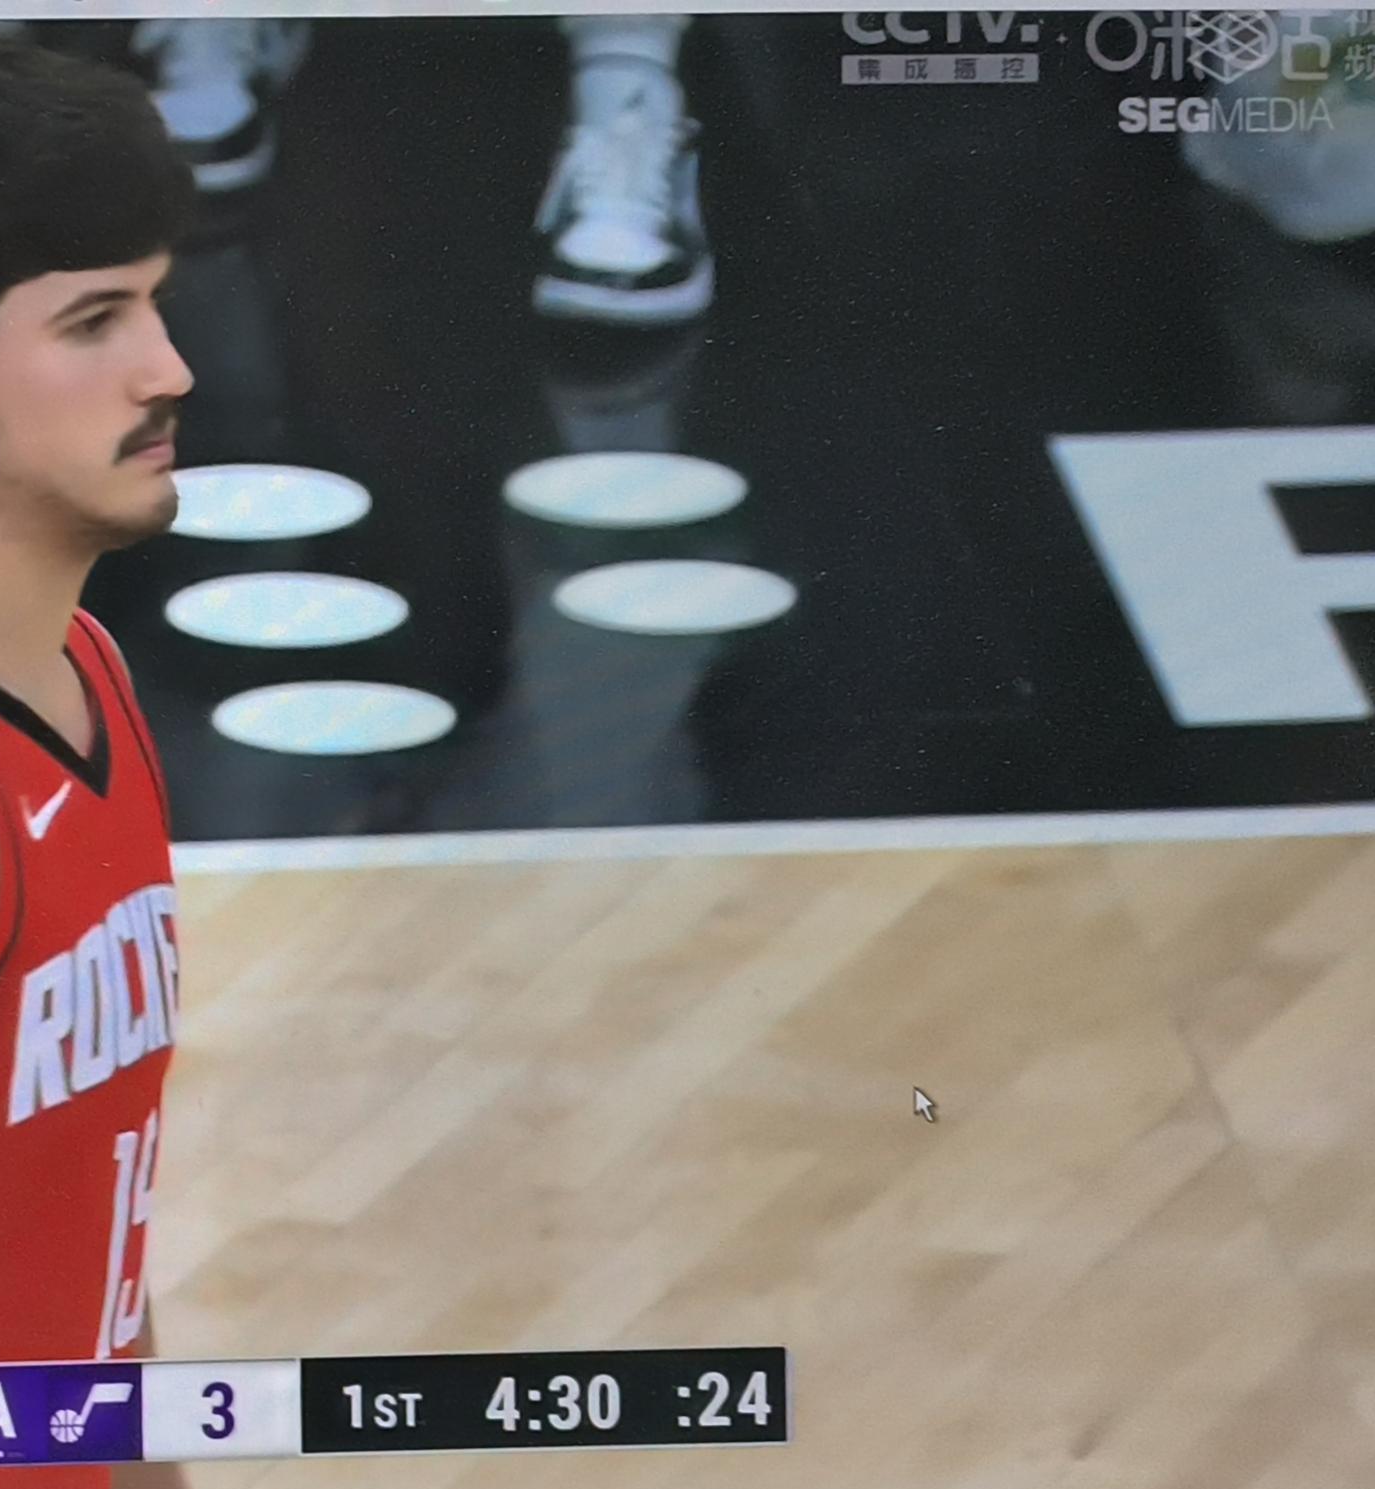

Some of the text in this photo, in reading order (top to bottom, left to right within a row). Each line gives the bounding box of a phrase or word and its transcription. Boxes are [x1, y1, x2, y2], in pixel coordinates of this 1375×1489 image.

[201, 1381, 235, 1440] 3
[342, 1371, 772, 1432] 1ST 4:30 :24
